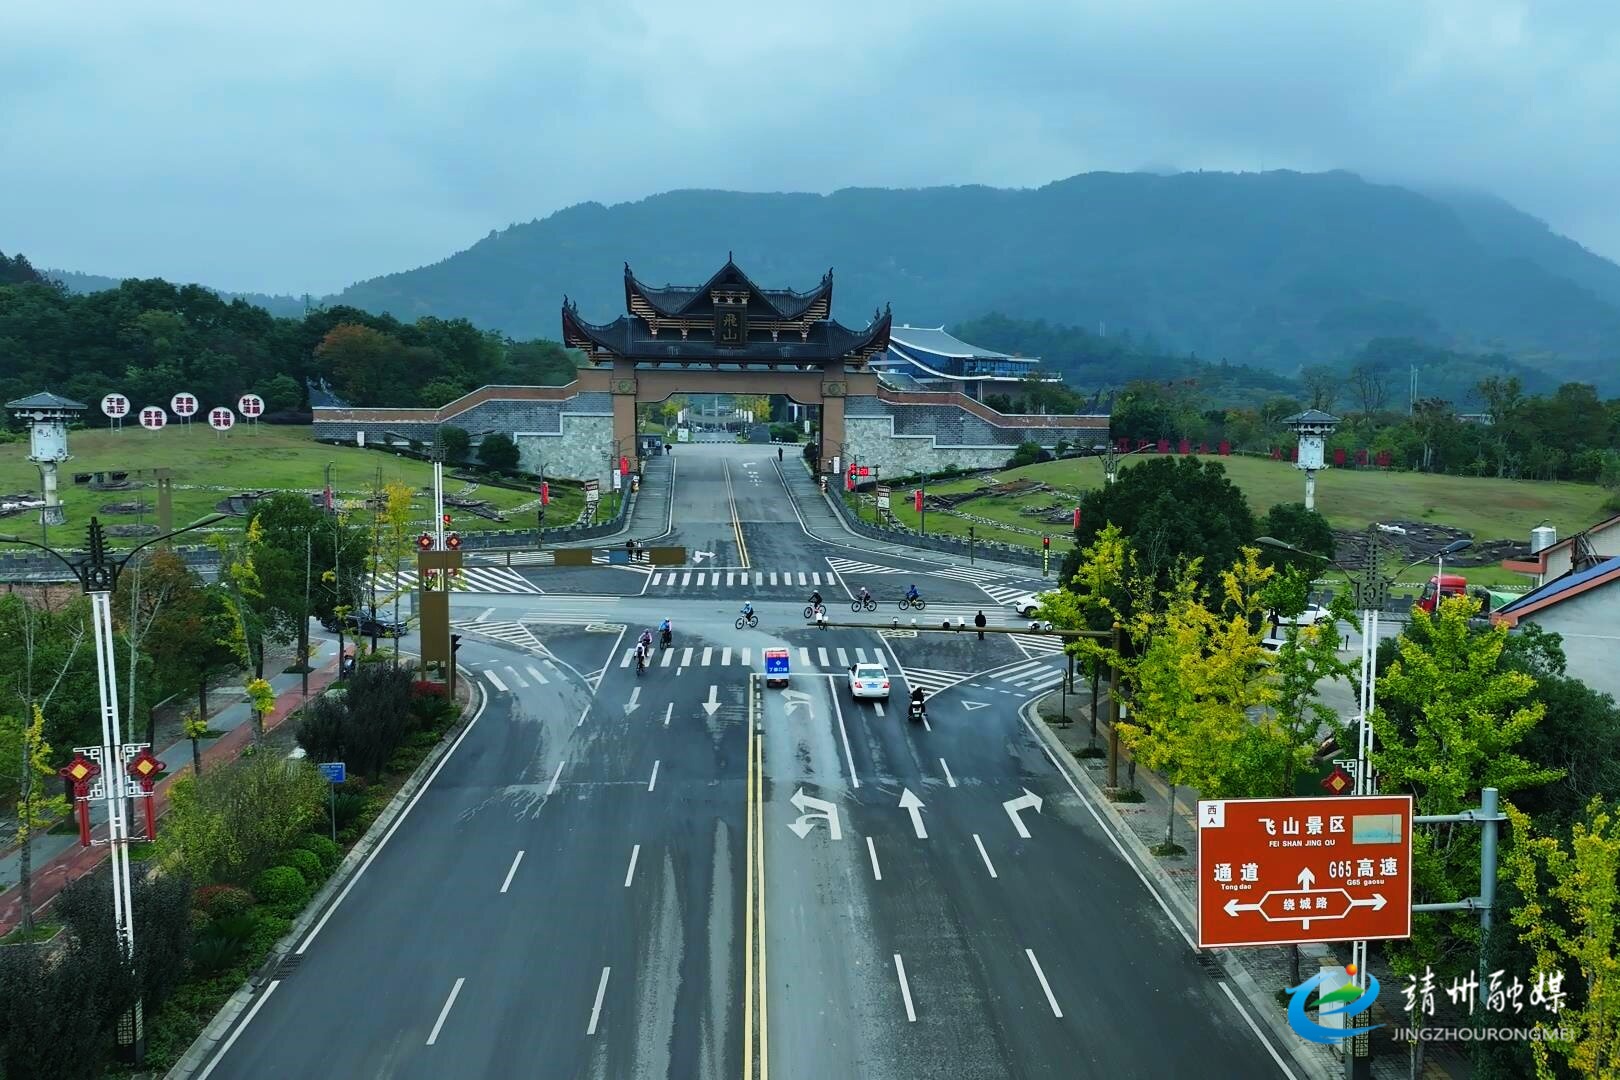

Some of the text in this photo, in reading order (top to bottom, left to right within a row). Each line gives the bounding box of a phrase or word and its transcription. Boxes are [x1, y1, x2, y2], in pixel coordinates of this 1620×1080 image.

[1207, 805, 1217, 815] 西
[1258, 815, 1346, 836] 飞山景区
[1269, 840, 1280, 848] FEI
[1213, 862, 1259, 882] 通道
[1221, 883, 1239, 891] Tong
[1363, 878, 1385, 886] gaosu
[1283, 897, 1328, 911] 绕城路
